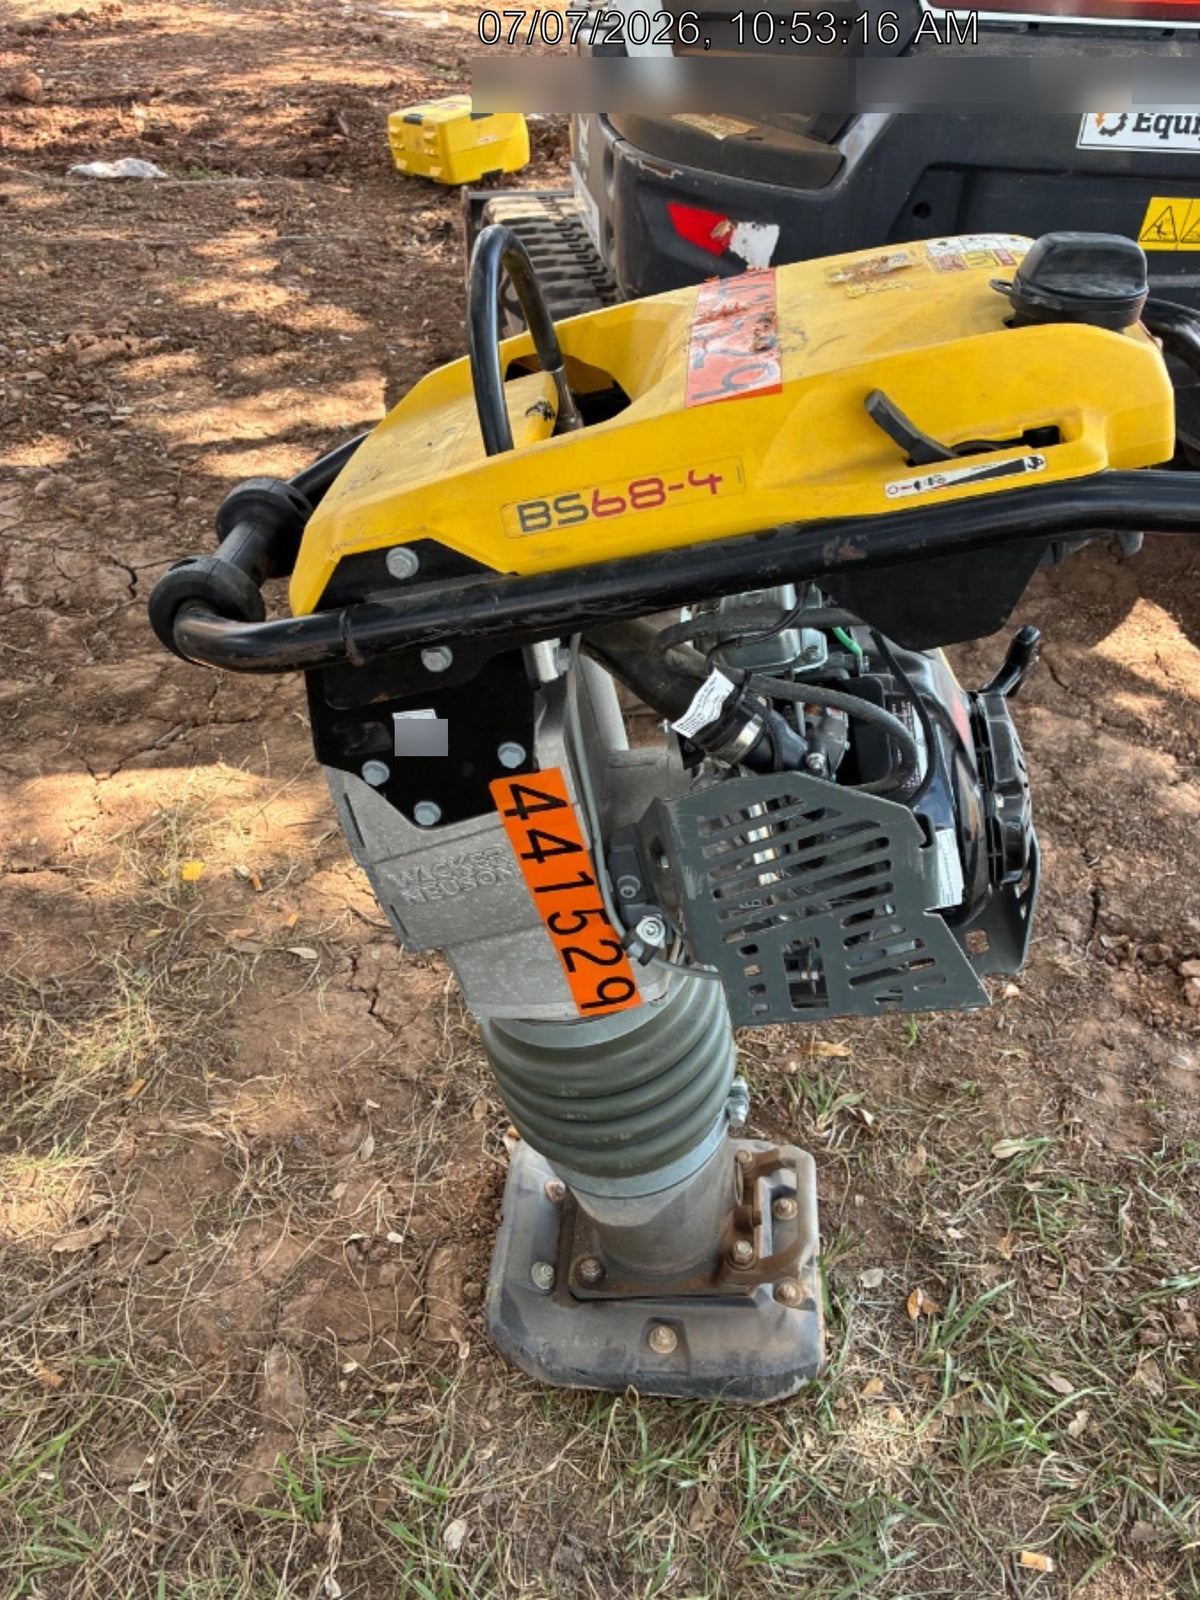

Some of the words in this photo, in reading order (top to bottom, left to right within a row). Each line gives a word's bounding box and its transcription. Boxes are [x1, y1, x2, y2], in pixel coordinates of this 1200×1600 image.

[1132, 112, 1200, 141] Equi
[516, 469, 723, 533] BS68-4
[504, 784, 636, 1009] 441529
